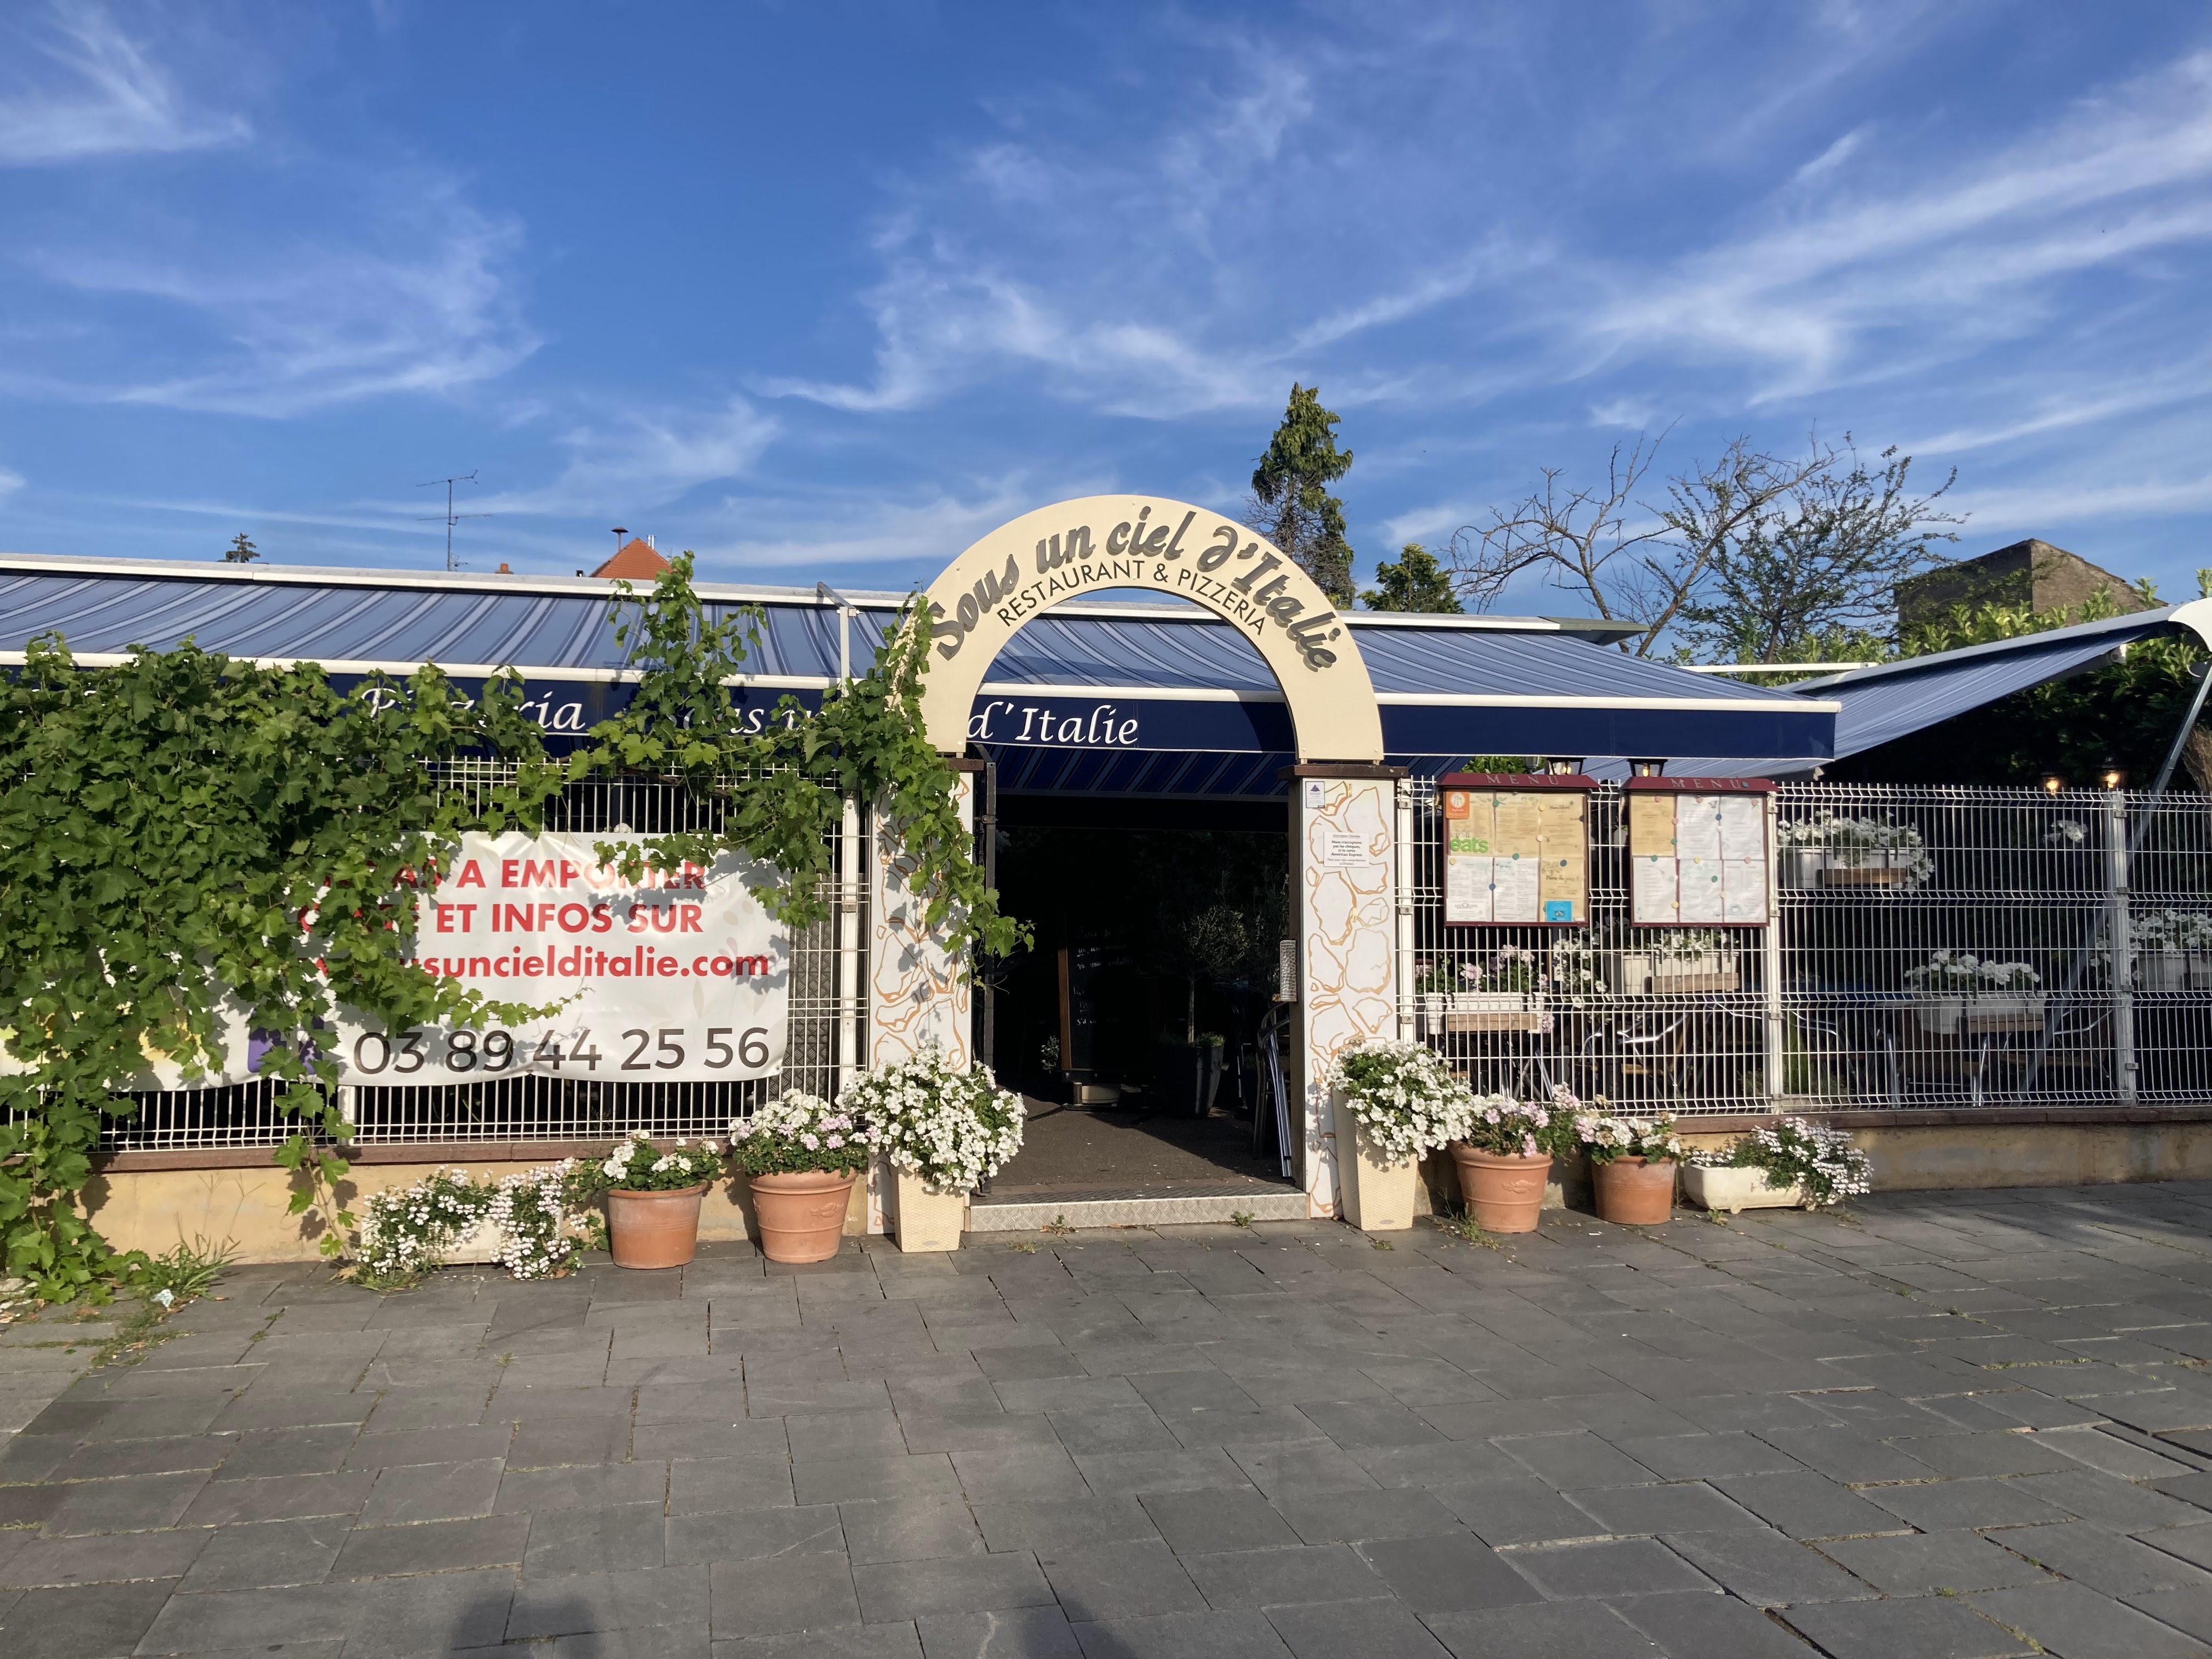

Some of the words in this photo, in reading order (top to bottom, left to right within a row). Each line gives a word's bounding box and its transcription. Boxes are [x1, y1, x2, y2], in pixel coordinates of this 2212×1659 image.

[927, 554, 1019, 661] Sous
[1036, 526, 1096, 574] un
[1106, 506, 1197, 561] ciel
[1197, 525, 1341, 672] d'Italie
[996, 560, 1145, 627] RESTAURANT
[1153, 563, 1168, 583] &
[1177, 568, 1266, 636] PIZZERIA
[966, 701, 1138, 744] d'Italie
[1485, 774, 1559, 785] MENU
[1669, 777, 1742, 789] MENU
[1450, 837, 1489, 853] eats
[456, 859, 486, 888] A
[437, 904, 477, 932] ET
[493, 903, 612, 933] INFOS
[627, 903, 704, 933] SUR
[354, 1031, 424, 1074] 03
[445, 1030, 513, 1072] 89
[533, 1029, 602, 1071] 44
[621, 1028, 686, 1070] 25
[704, 1027, 769, 1069] 56
